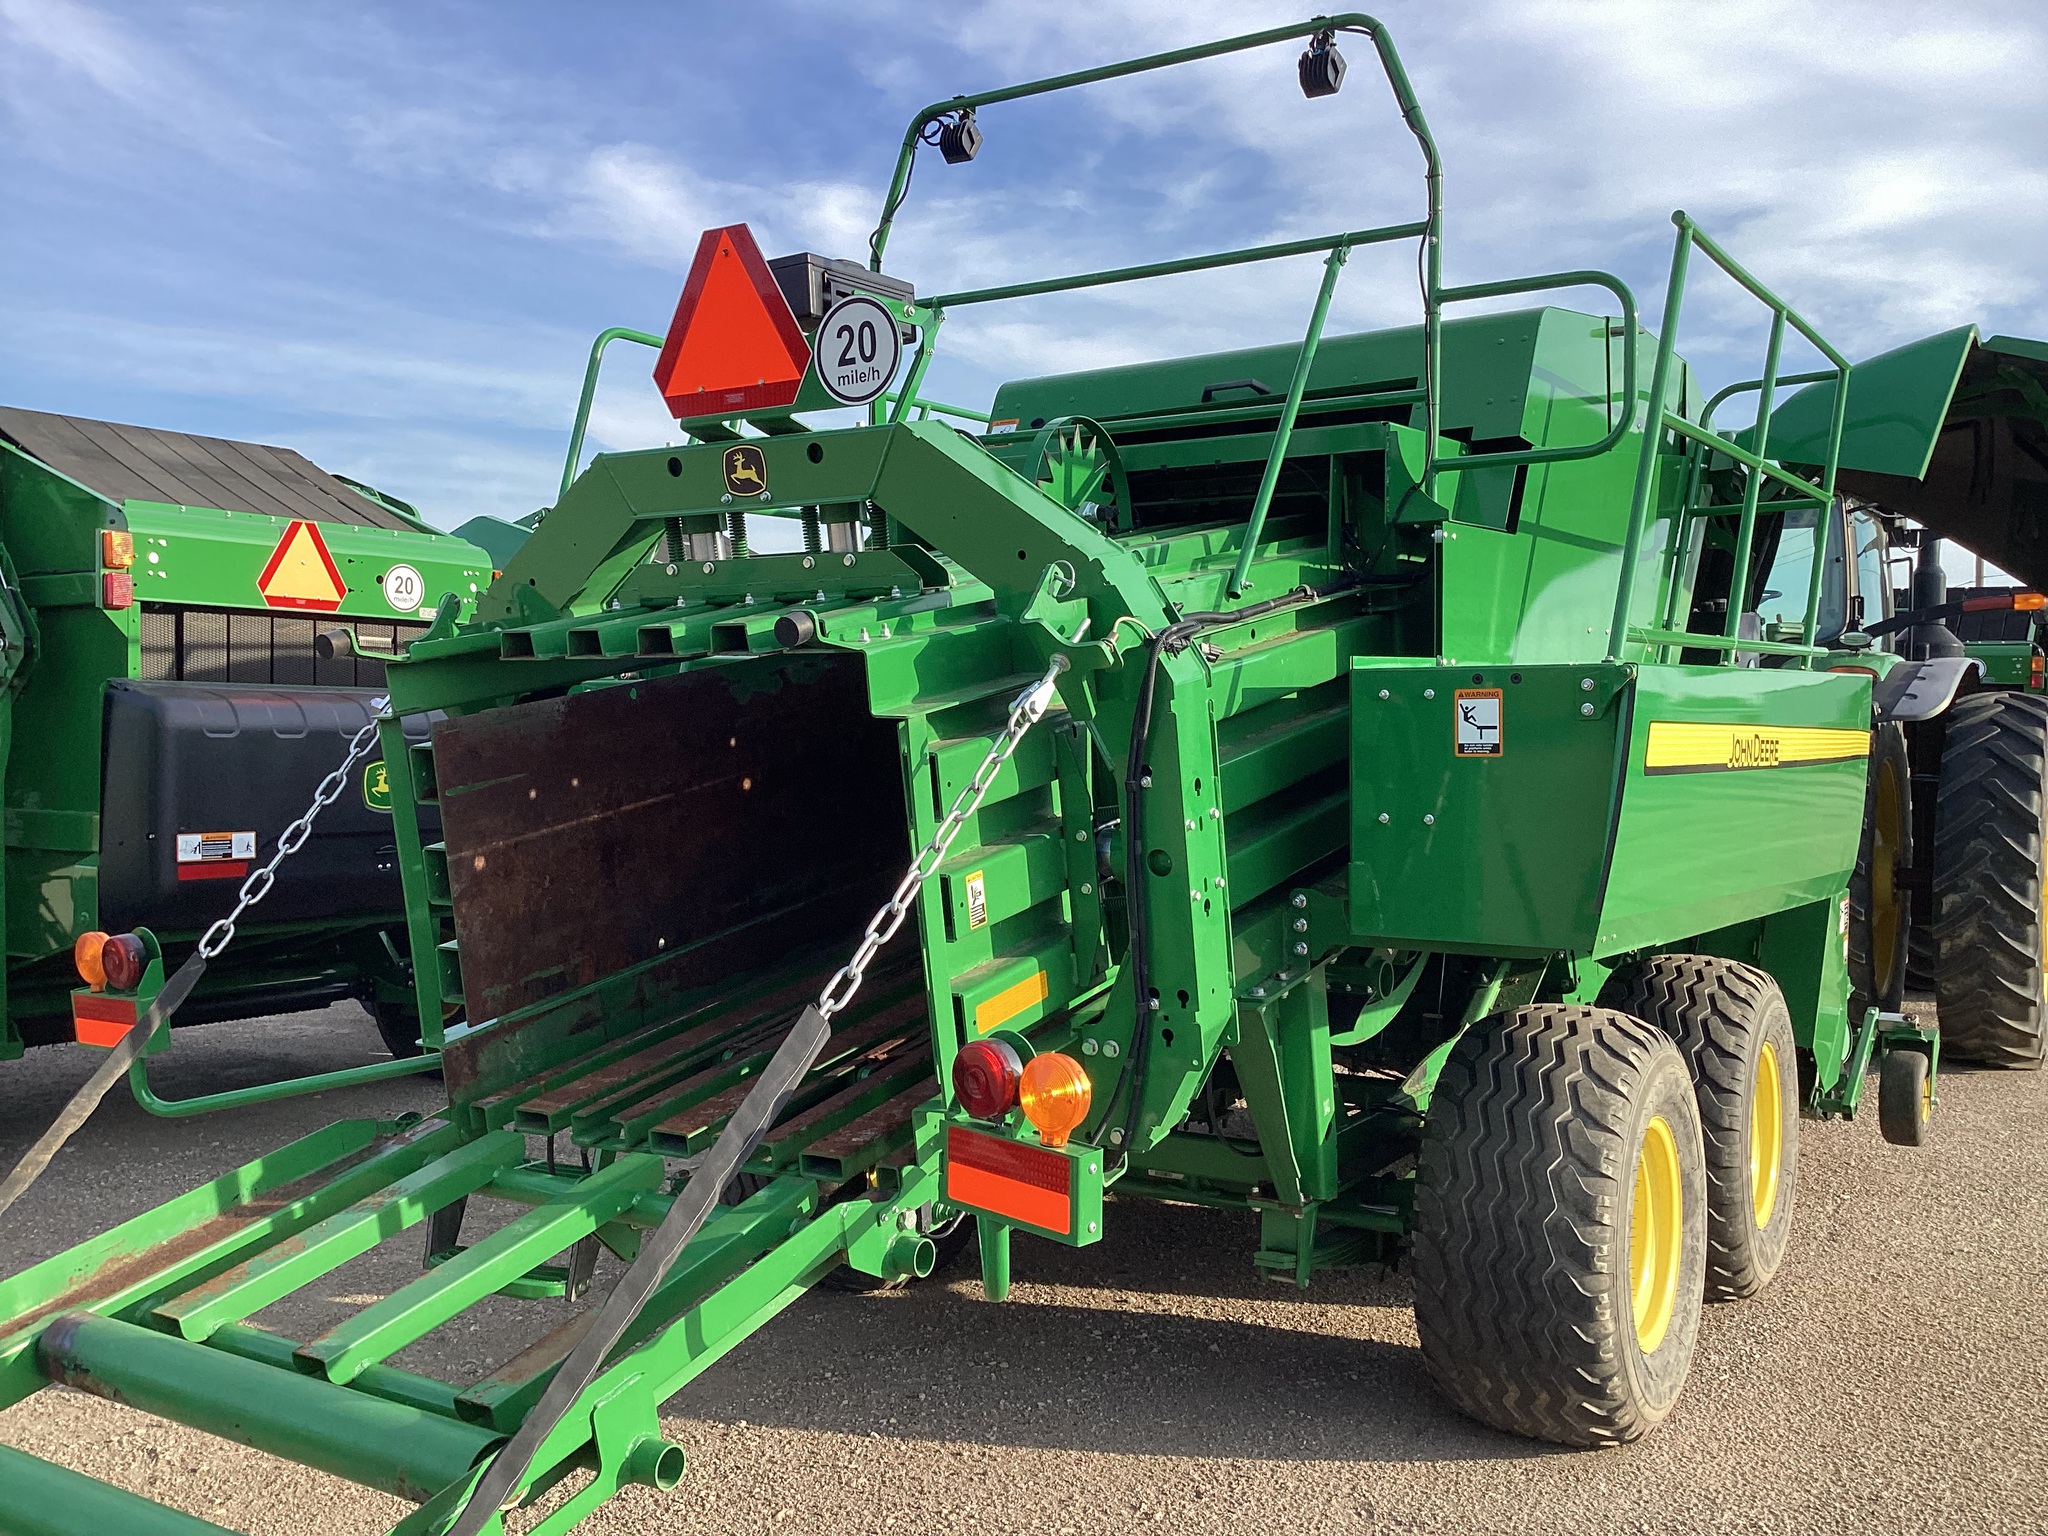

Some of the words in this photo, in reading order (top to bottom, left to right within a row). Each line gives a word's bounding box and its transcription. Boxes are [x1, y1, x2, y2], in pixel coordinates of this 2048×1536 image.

[836, 320, 877, 368] 20
[837, 366, 880, 387] mile/h
[394, 575, 414, 595] 20
[1728, 732, 1753, 764] JOHN
[1753, 733, 1780, 763] DEERE
